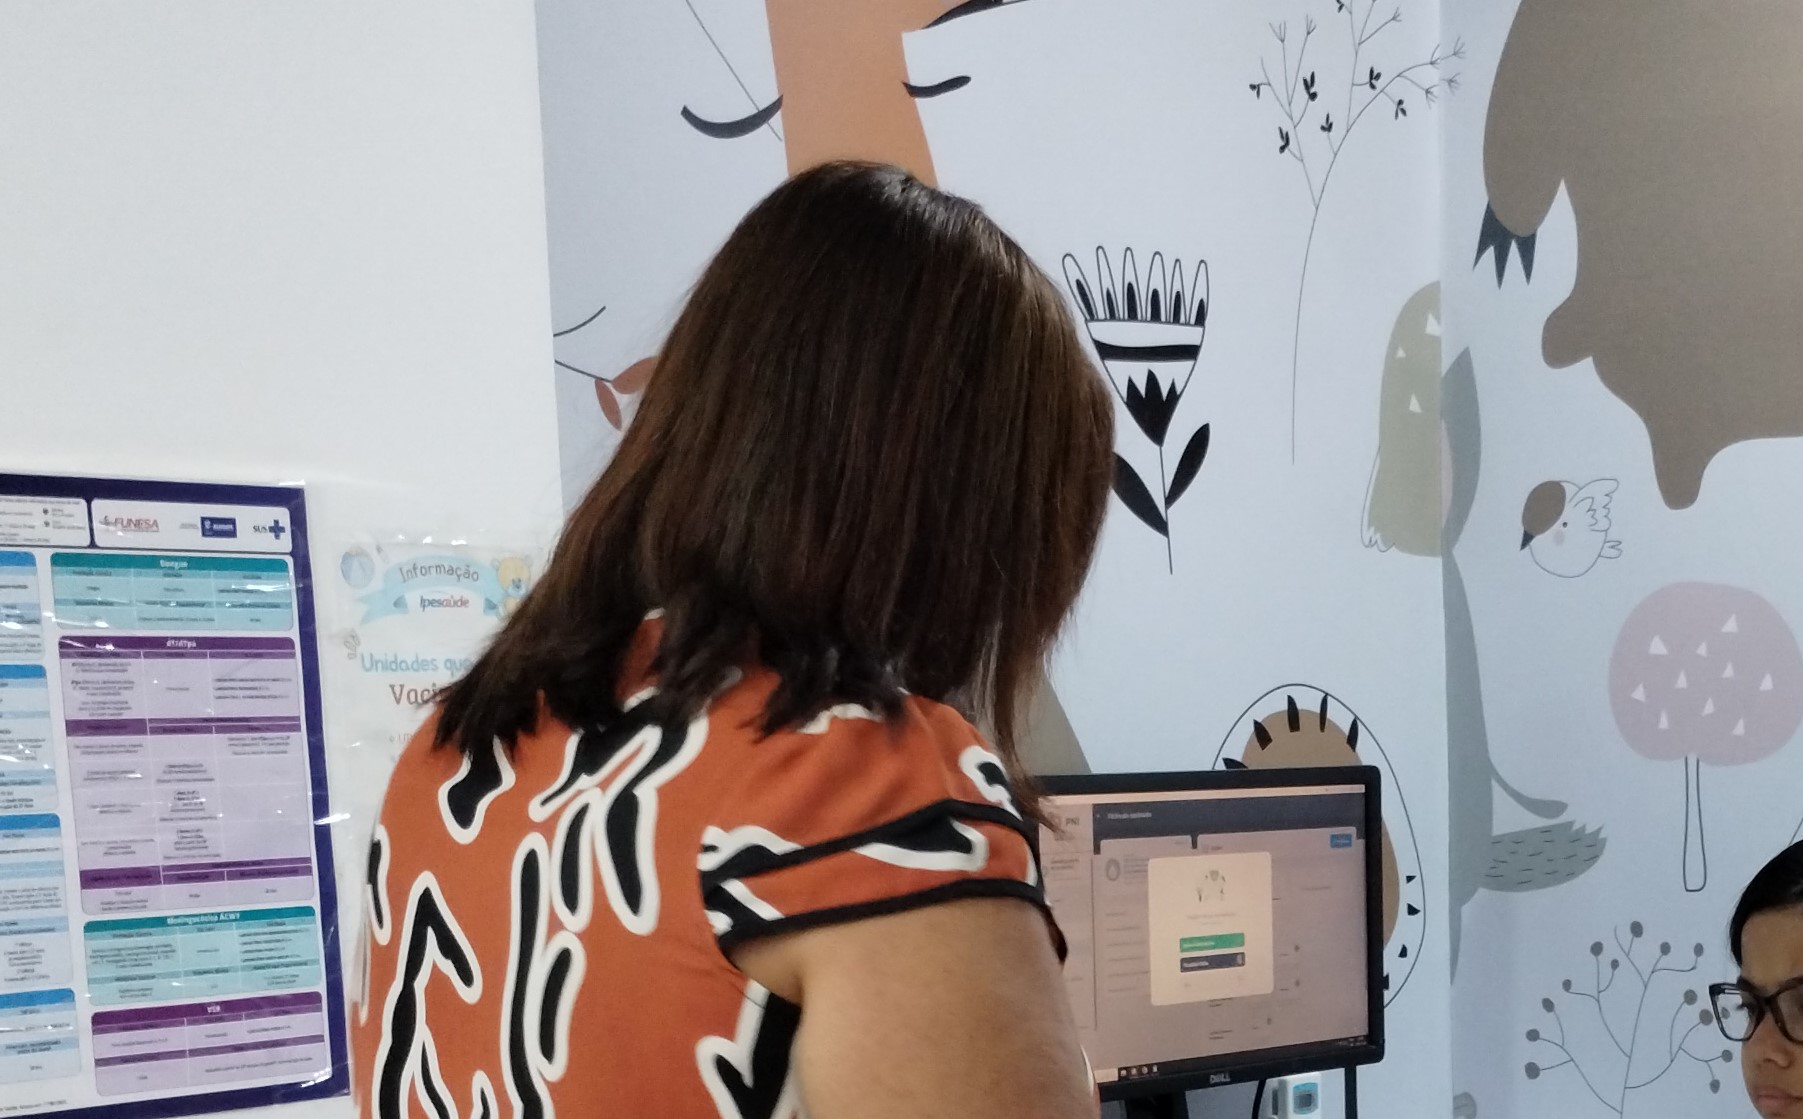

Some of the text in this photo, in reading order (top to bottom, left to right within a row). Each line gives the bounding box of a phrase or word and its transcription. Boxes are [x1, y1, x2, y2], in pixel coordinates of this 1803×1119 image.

[114, 517, 160, 530] FUNESA
[399, 562, 480, 584] Informação
[419, 595, 470, 612] Ipesaúde
[361, 652, 472, 676] Unidades que
